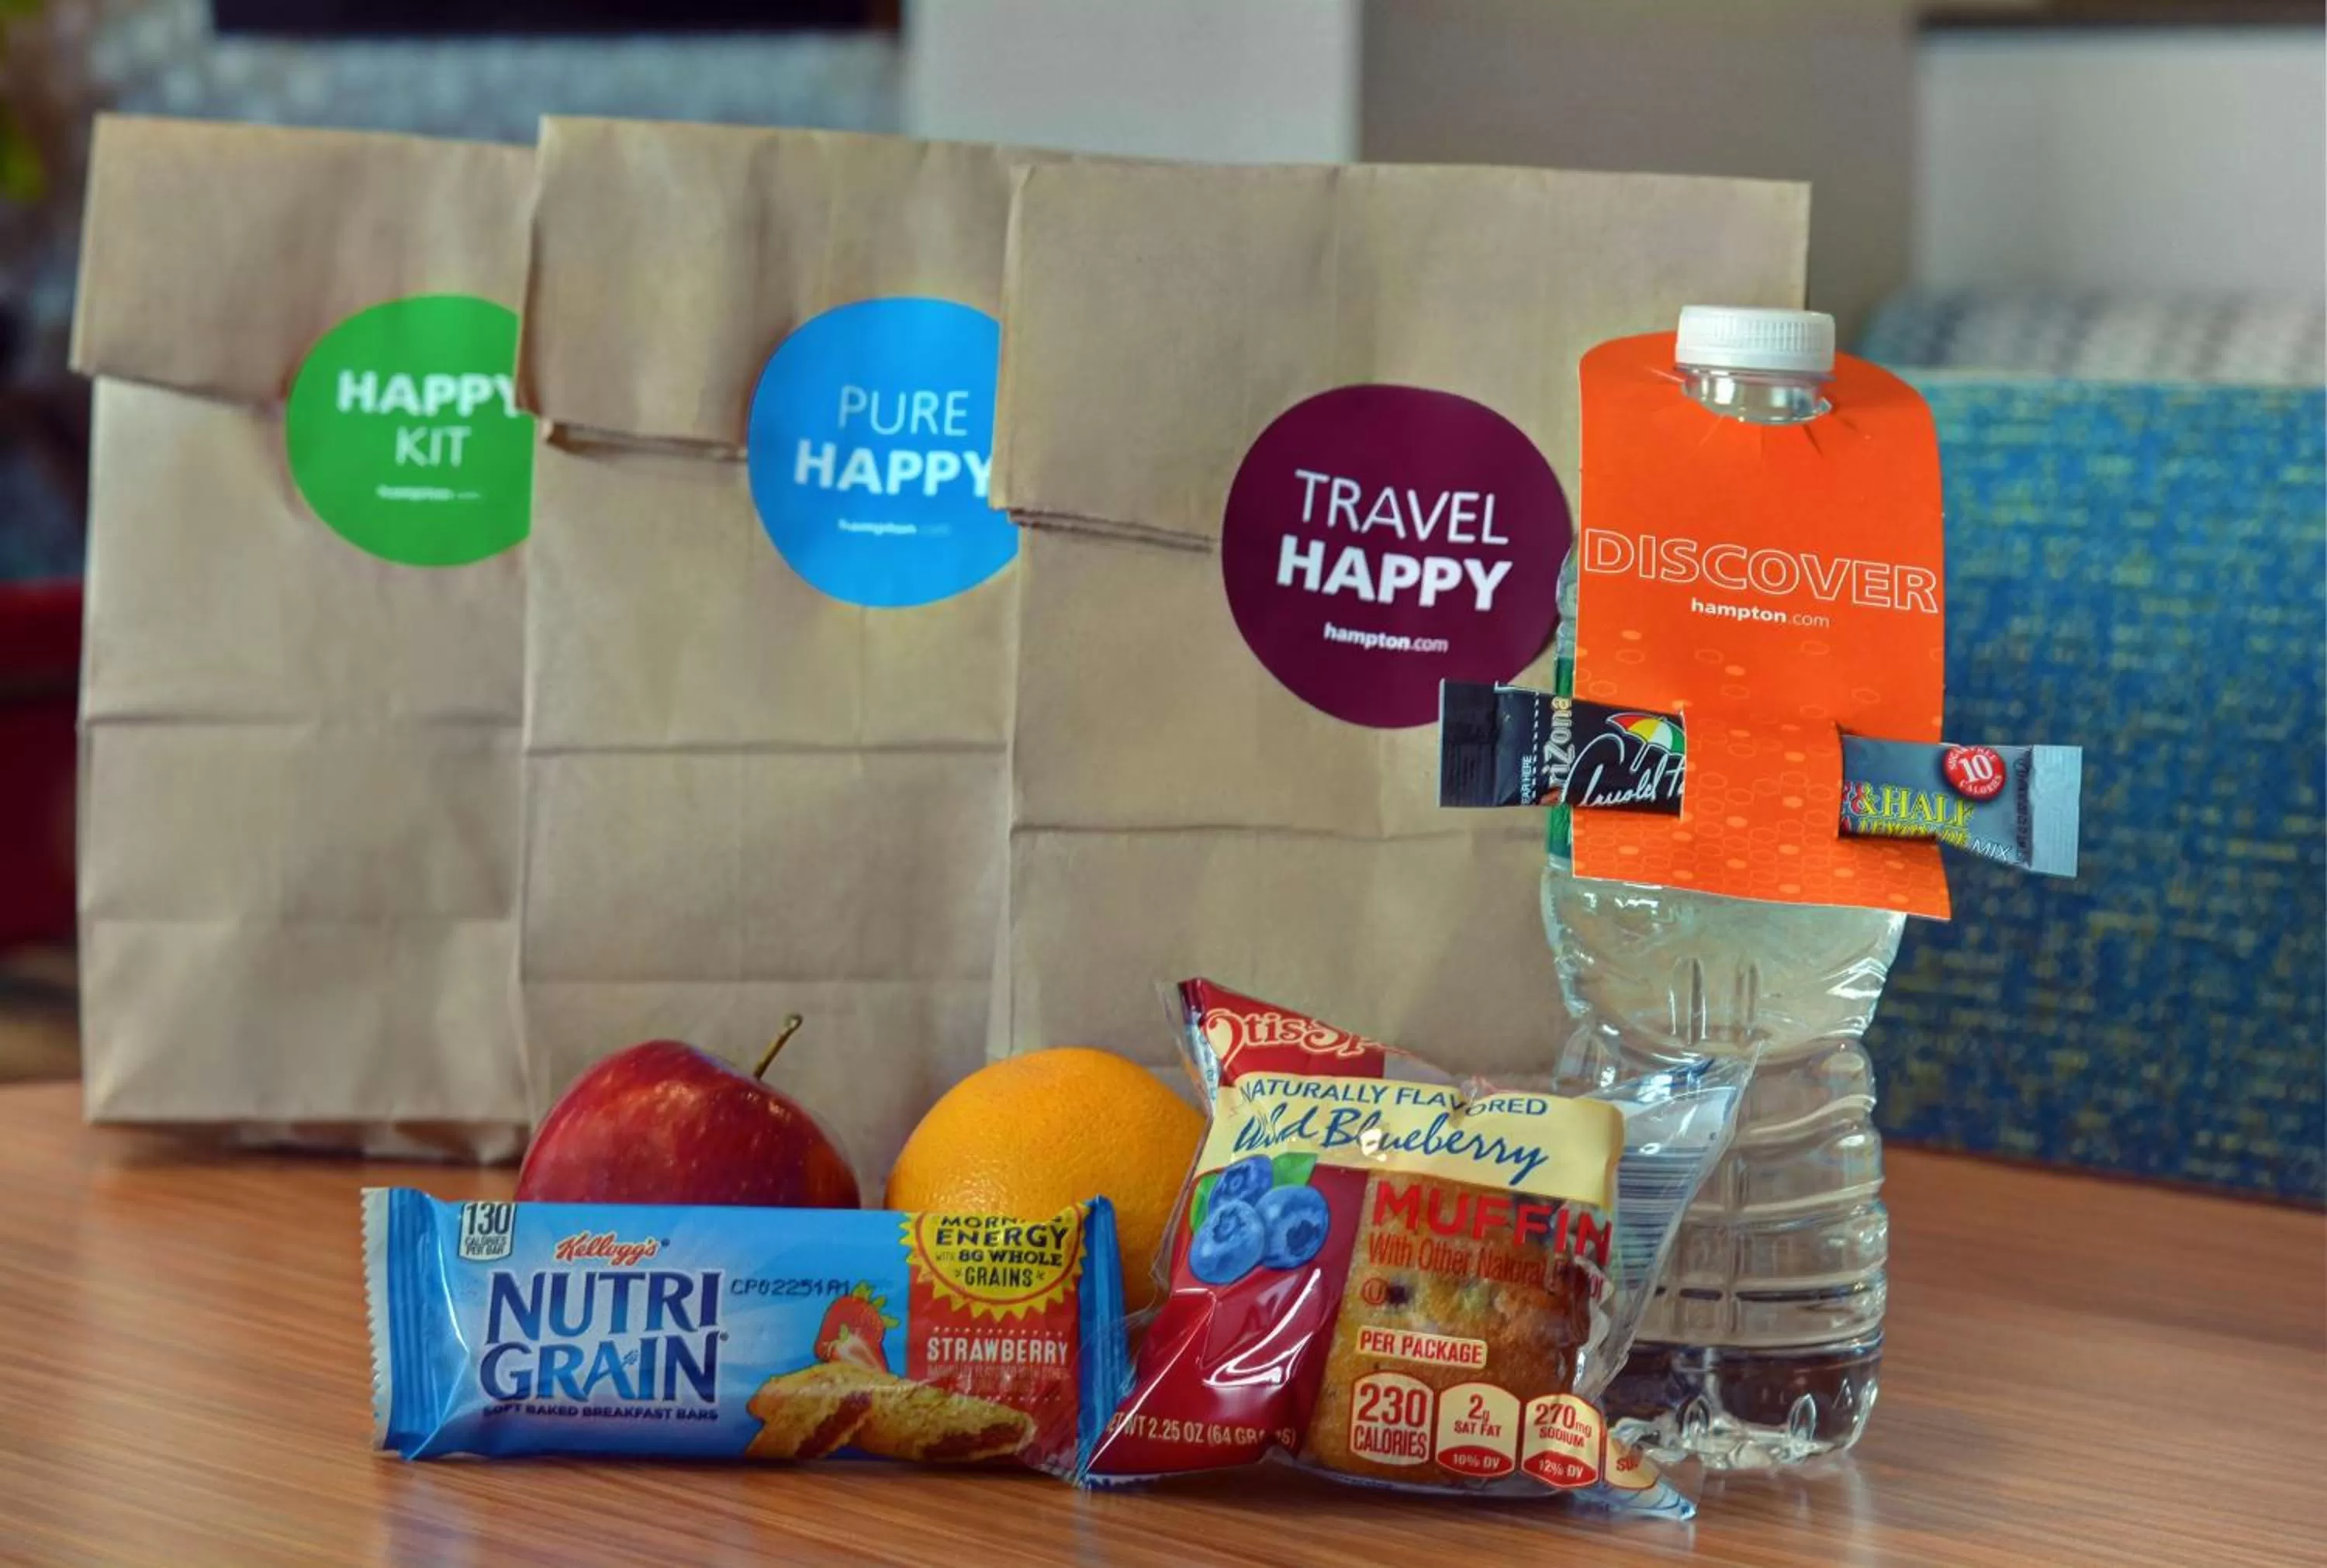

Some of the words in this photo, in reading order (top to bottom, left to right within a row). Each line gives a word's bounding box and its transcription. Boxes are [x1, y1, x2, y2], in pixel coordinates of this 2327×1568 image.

[838, 385, 969, 436] PURE
[395, 426, 472, 467] KIT
[794, 438, 992, 498] HAPPY
[1295, 468, 1508, 545] TRAVEL
[1276, 534, 1513, 611] HAPPY
[1585, 528, 1938, 613] DISCOVER
[1691, 596, 1830, 628] hampton.com
[1323, 621, 1450, 652] hampton.com
[1957, 754, 1993, 782] 10
[1971, 838, 2011, 861] MIX
[1240, 1079, 1388, 1105] NATURALLY
[1322, 1107, 1550, 1186] Blueberry
[466, 1202, 512, 1235] 130
[1371, 1179, 1613, 1267] MUFFIN
[555, 1231, 659, 1266] Kellogg's
[935, 1225, 1069, 1249] ENERGY
[958, 1249, 984, 1262] 8G
[987, 1249, 1063, 1266] WHOLE
[1368, 1231, 1412, 1267] With
[1418, 1237, 1471, 1277] Other
[964, 1266, 1034, 1288] GRAINS
[486, 1271, 721, 1344] NUTRI
[926, 1337, 1068, 1365] STRAWBERRY
[1360, 1330, 1395, 1354] PER
[1401, 1335, 1483, 1364] PACKAGE
[479, 1329, 721, 1404] GRAIN
[483, 1404, 520, 1418] SOFT
[524, 1404, 579, 1418] BAKED
[582, 1405, 673, 1421] BREAKFAST
[676, 1407, 719, 1421] BARS
[1357, 1383, 1428, 1428] 230
[1147, 1417, 1181, 1442] 2.25
[1183, 1421, 1205, 1444] OZ
[1207, 1423, 1233, 1447] (64
[1354, 1425, 1428, 1459] CALORIES
[1454, 1420, 1476, 1434] SAT
[1480, 1421, 1502, 1438] FAT
[1539, 1426, 1585, 1448] SODIUM
[1452, 1453, 1480, 1466] 10%
[1483, 1456, 1500, 1470] DV
[1539, 1459, 1565, 1474] 12%
[1566, 1463, 1584, 1479] DV
